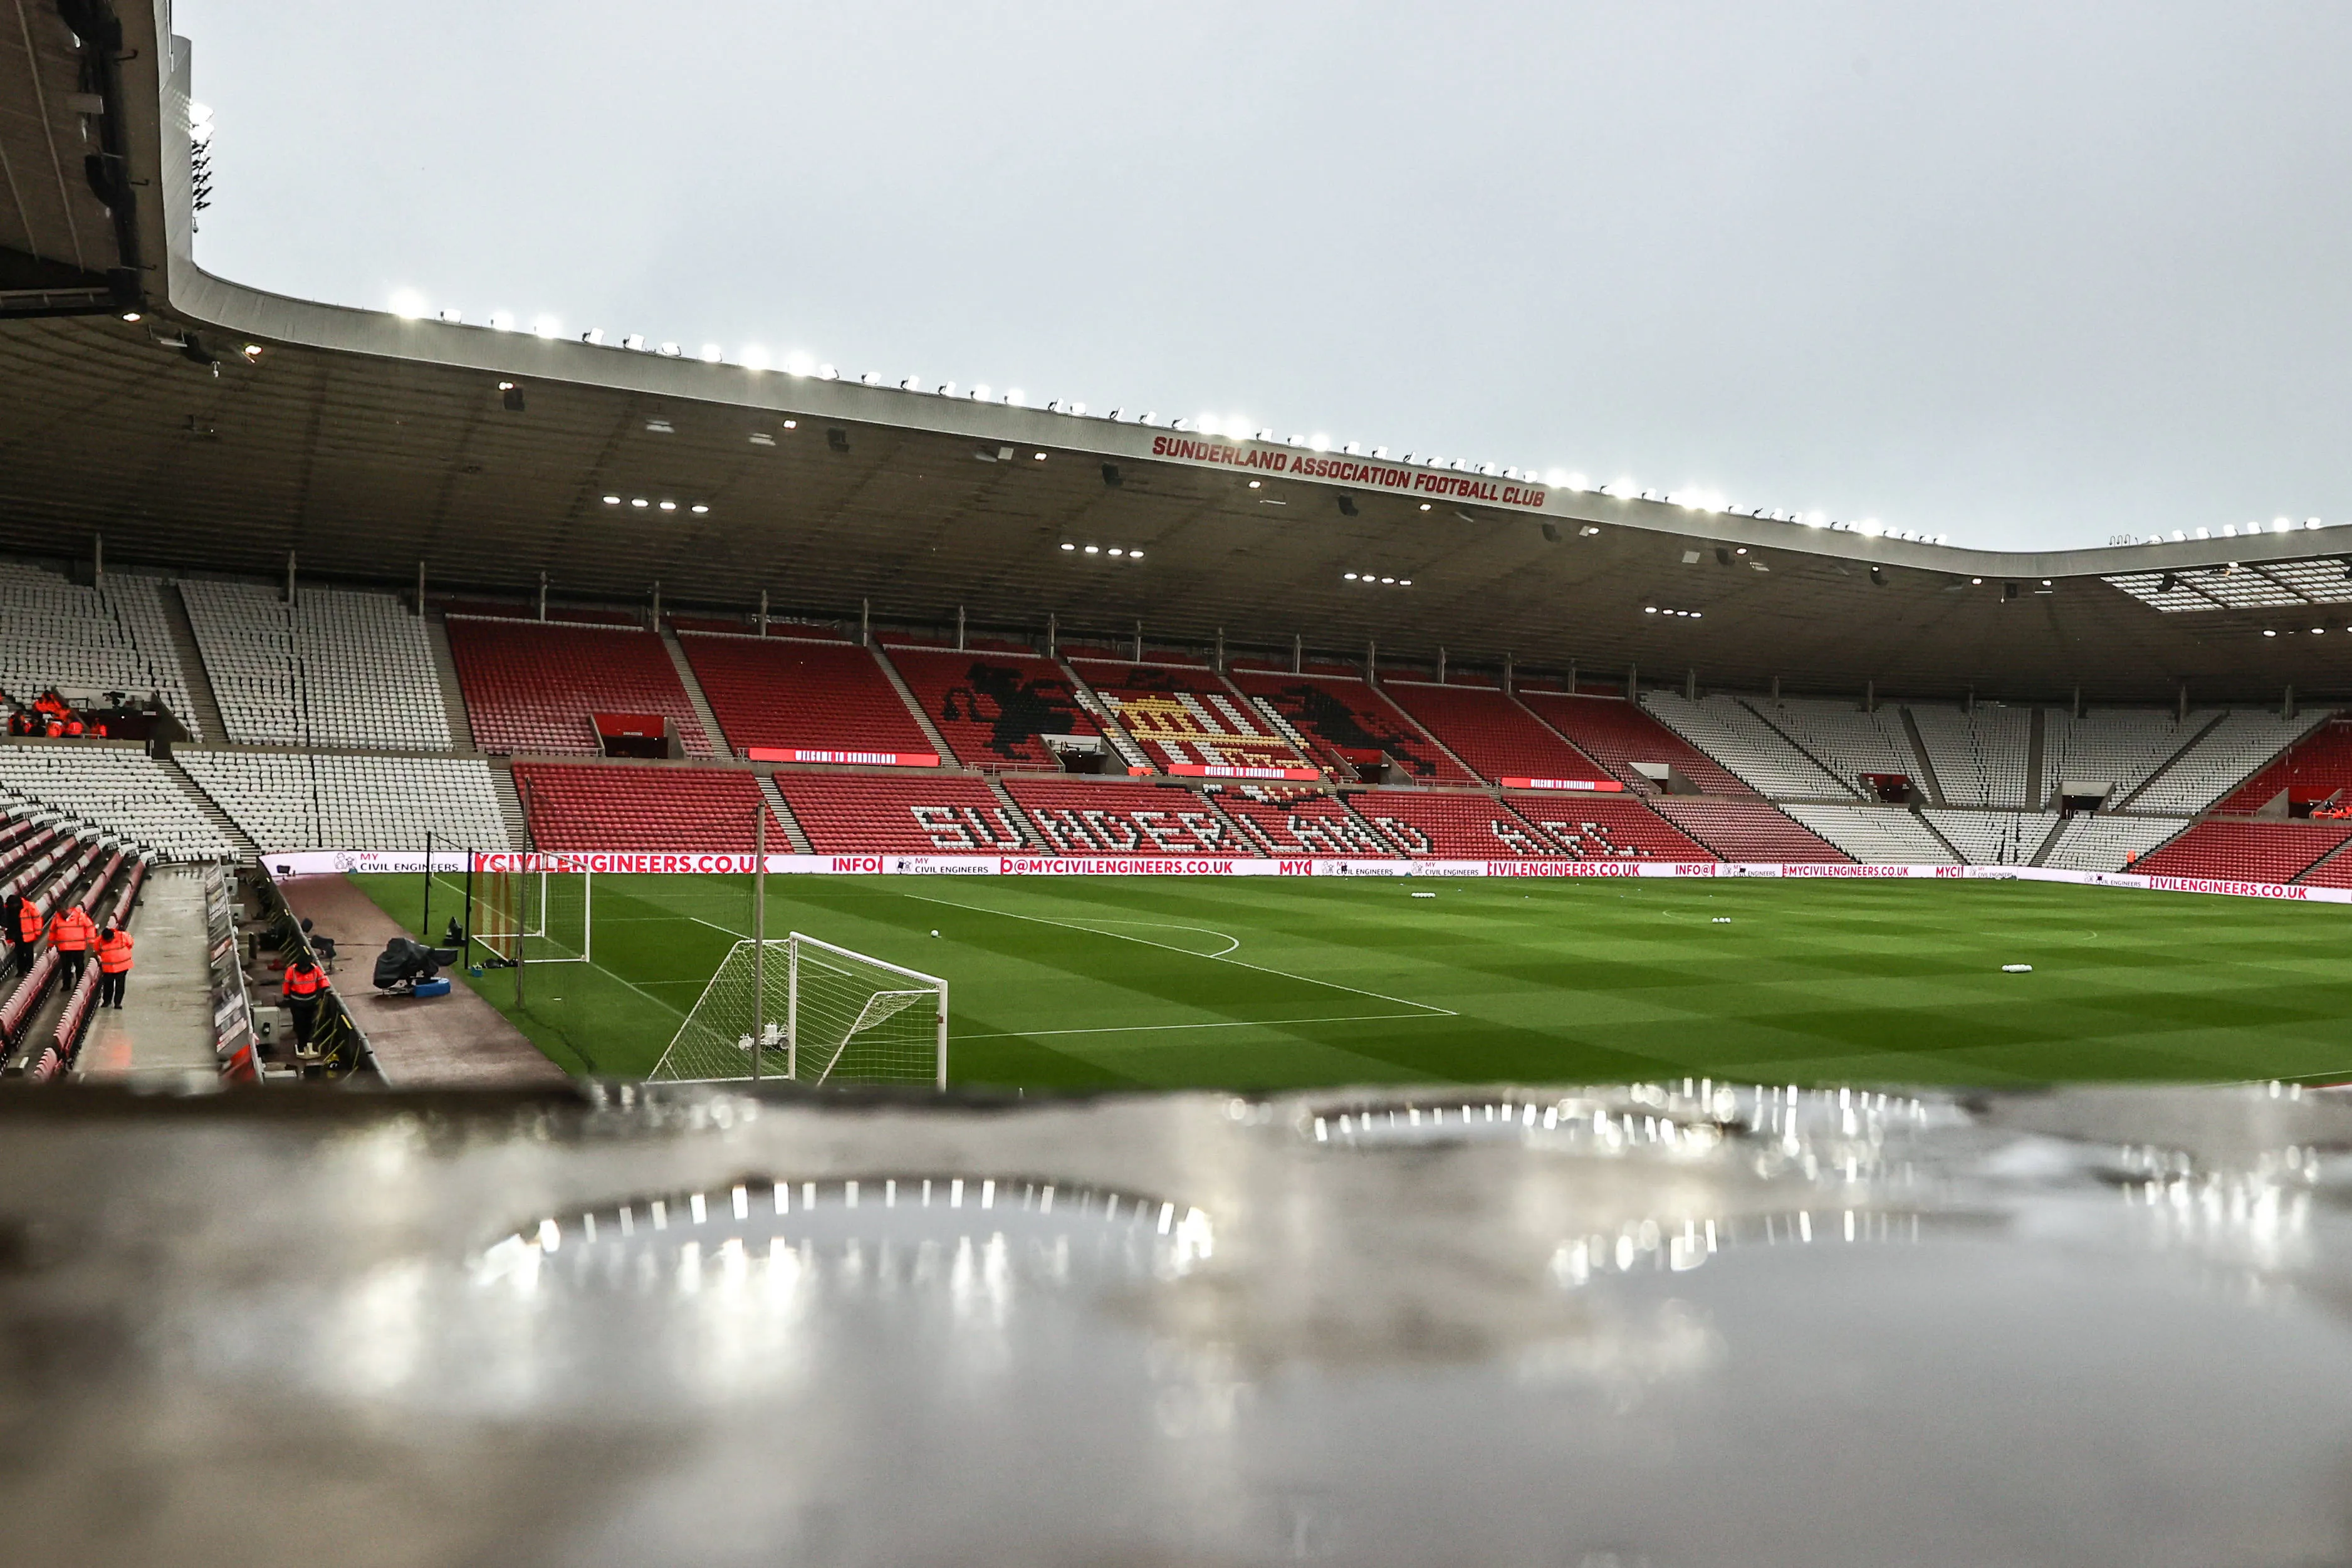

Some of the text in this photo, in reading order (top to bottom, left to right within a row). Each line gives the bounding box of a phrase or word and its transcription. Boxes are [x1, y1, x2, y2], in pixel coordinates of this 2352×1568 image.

[1152, 436, 1545, 507] SUNDERLAND ASSOCIATION FOOTBALL CLUB
[835, 751, 845, 762] TO
[911, 806, 1431, 853] SUNDERLAND
[360, 863, 459, 872] CIVIL ENGINEERS
